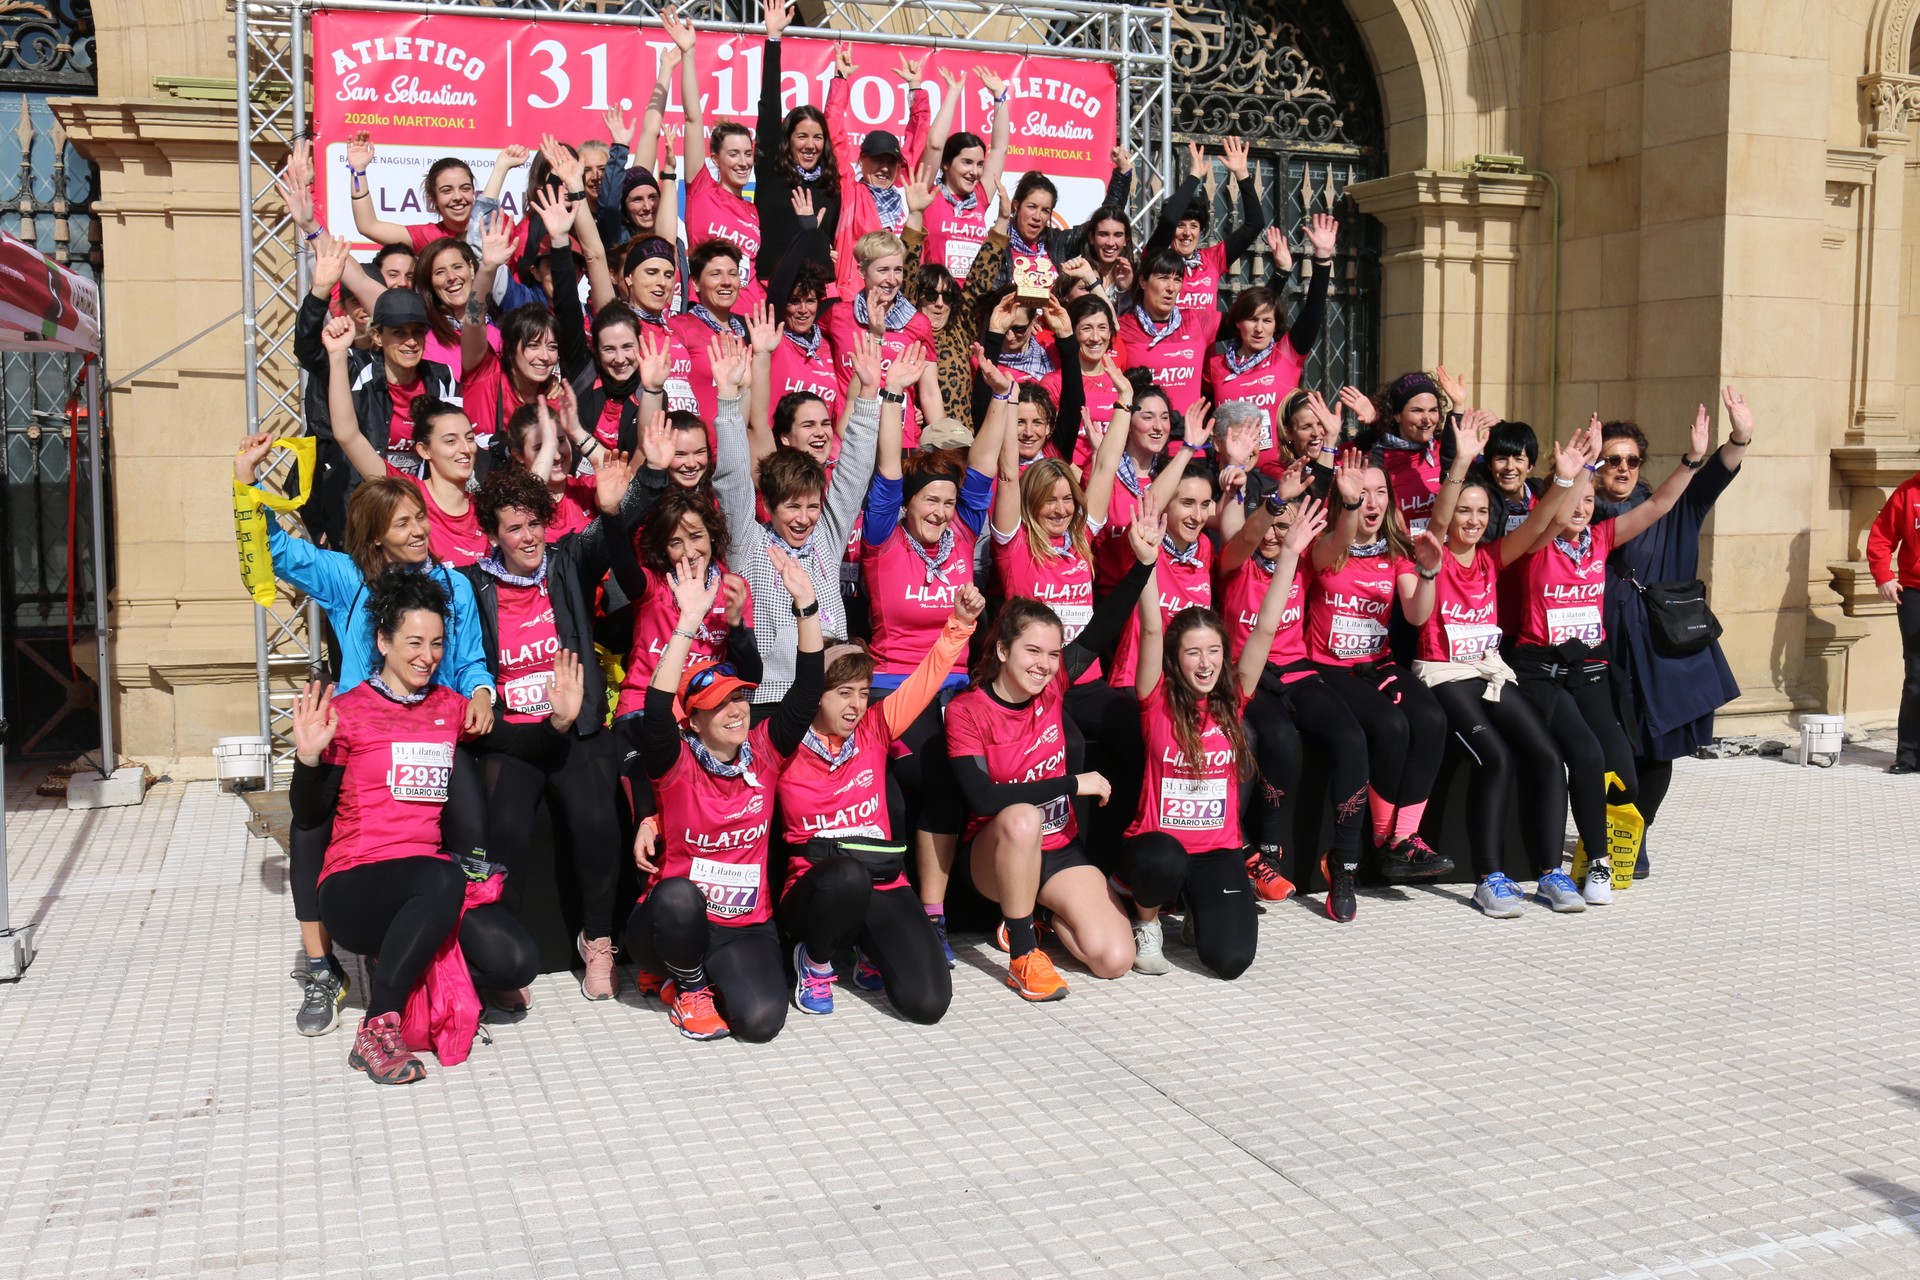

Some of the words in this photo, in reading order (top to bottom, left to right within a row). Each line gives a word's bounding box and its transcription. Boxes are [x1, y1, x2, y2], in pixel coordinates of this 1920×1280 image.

[331, 36, 486, 81] ATLETICO
[527, 39, 632, 111] 31.
[336, 73, 378, 102] San
[384, 75, 477, 106] Sebastian
[344, 112, 390, 126] 2020ko
[393, 116, 464, 129] MARTXOAK
[468, 118, 476, 129] 1
[1021, 110, 1094, 140] Sebastian
[380, 156, 420, 166] NAGUSIA
[1027, 146, 1083, 161] MARTXOAK
[1085, 151, 1092, 161] 1
[668, 398, 698, 412] 3052
[1543, 581, 1605, 600] LILATON
[1325, 590, 1389, 616] LILATON
[1346, 620, 1372, 629] Lilaton
[1554, 623, 1598, 642] 2975
[1334, 633, 1381, 650] 3051
[1455, 634, 1498, 655] 2974
[521, 702, 551, 714] DIARIO
[411, 747, 441, 757] Lilaton
[398, 765, 449, 788] 2939
[405, 787, 433, 797] DIARIO
[1164, 781, 1176, 791] 31.
[802, 793, 879, 832] LILATON
[1166, 799, 1222, 818] 2979
[1172, 818, 1200, 826] DIARIO
[1201, 818, 1224, 826] VASCO
[685, 819, 768, 849] LILATON
[694, 862, 707, 873] 31.
[710, 866, 742, 877] Lilaton
